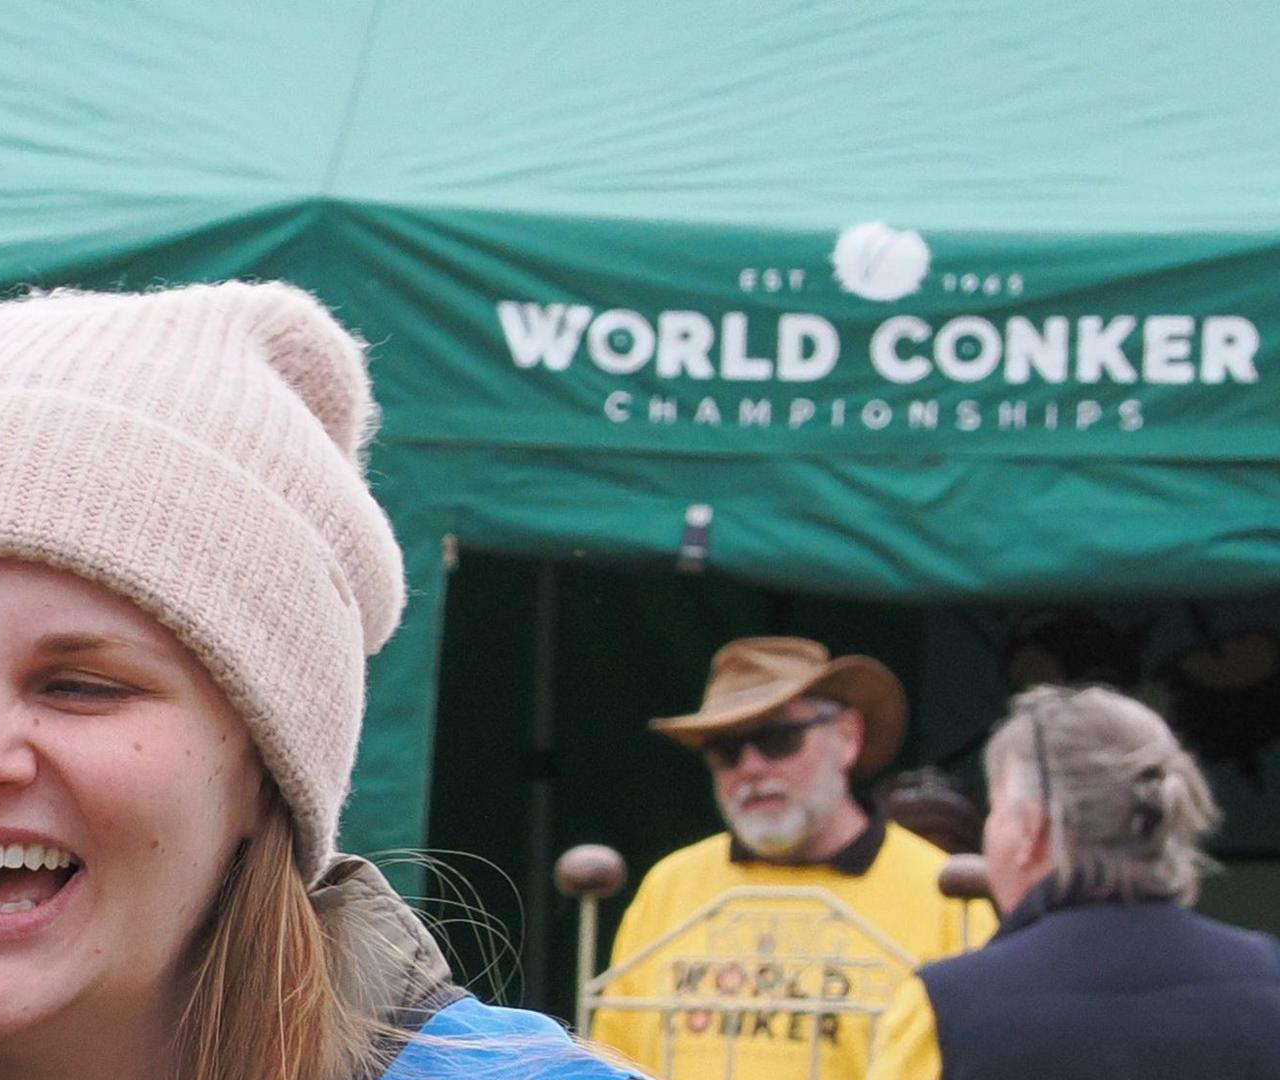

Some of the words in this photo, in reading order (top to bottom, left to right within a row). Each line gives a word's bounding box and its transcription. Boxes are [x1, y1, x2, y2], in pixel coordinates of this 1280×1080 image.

[496, 300, 841, 382] WORLD
[869, 314, 1261, 385] CONKER
[604, 389, 1144, 432] CHAMPIONSHIPS
